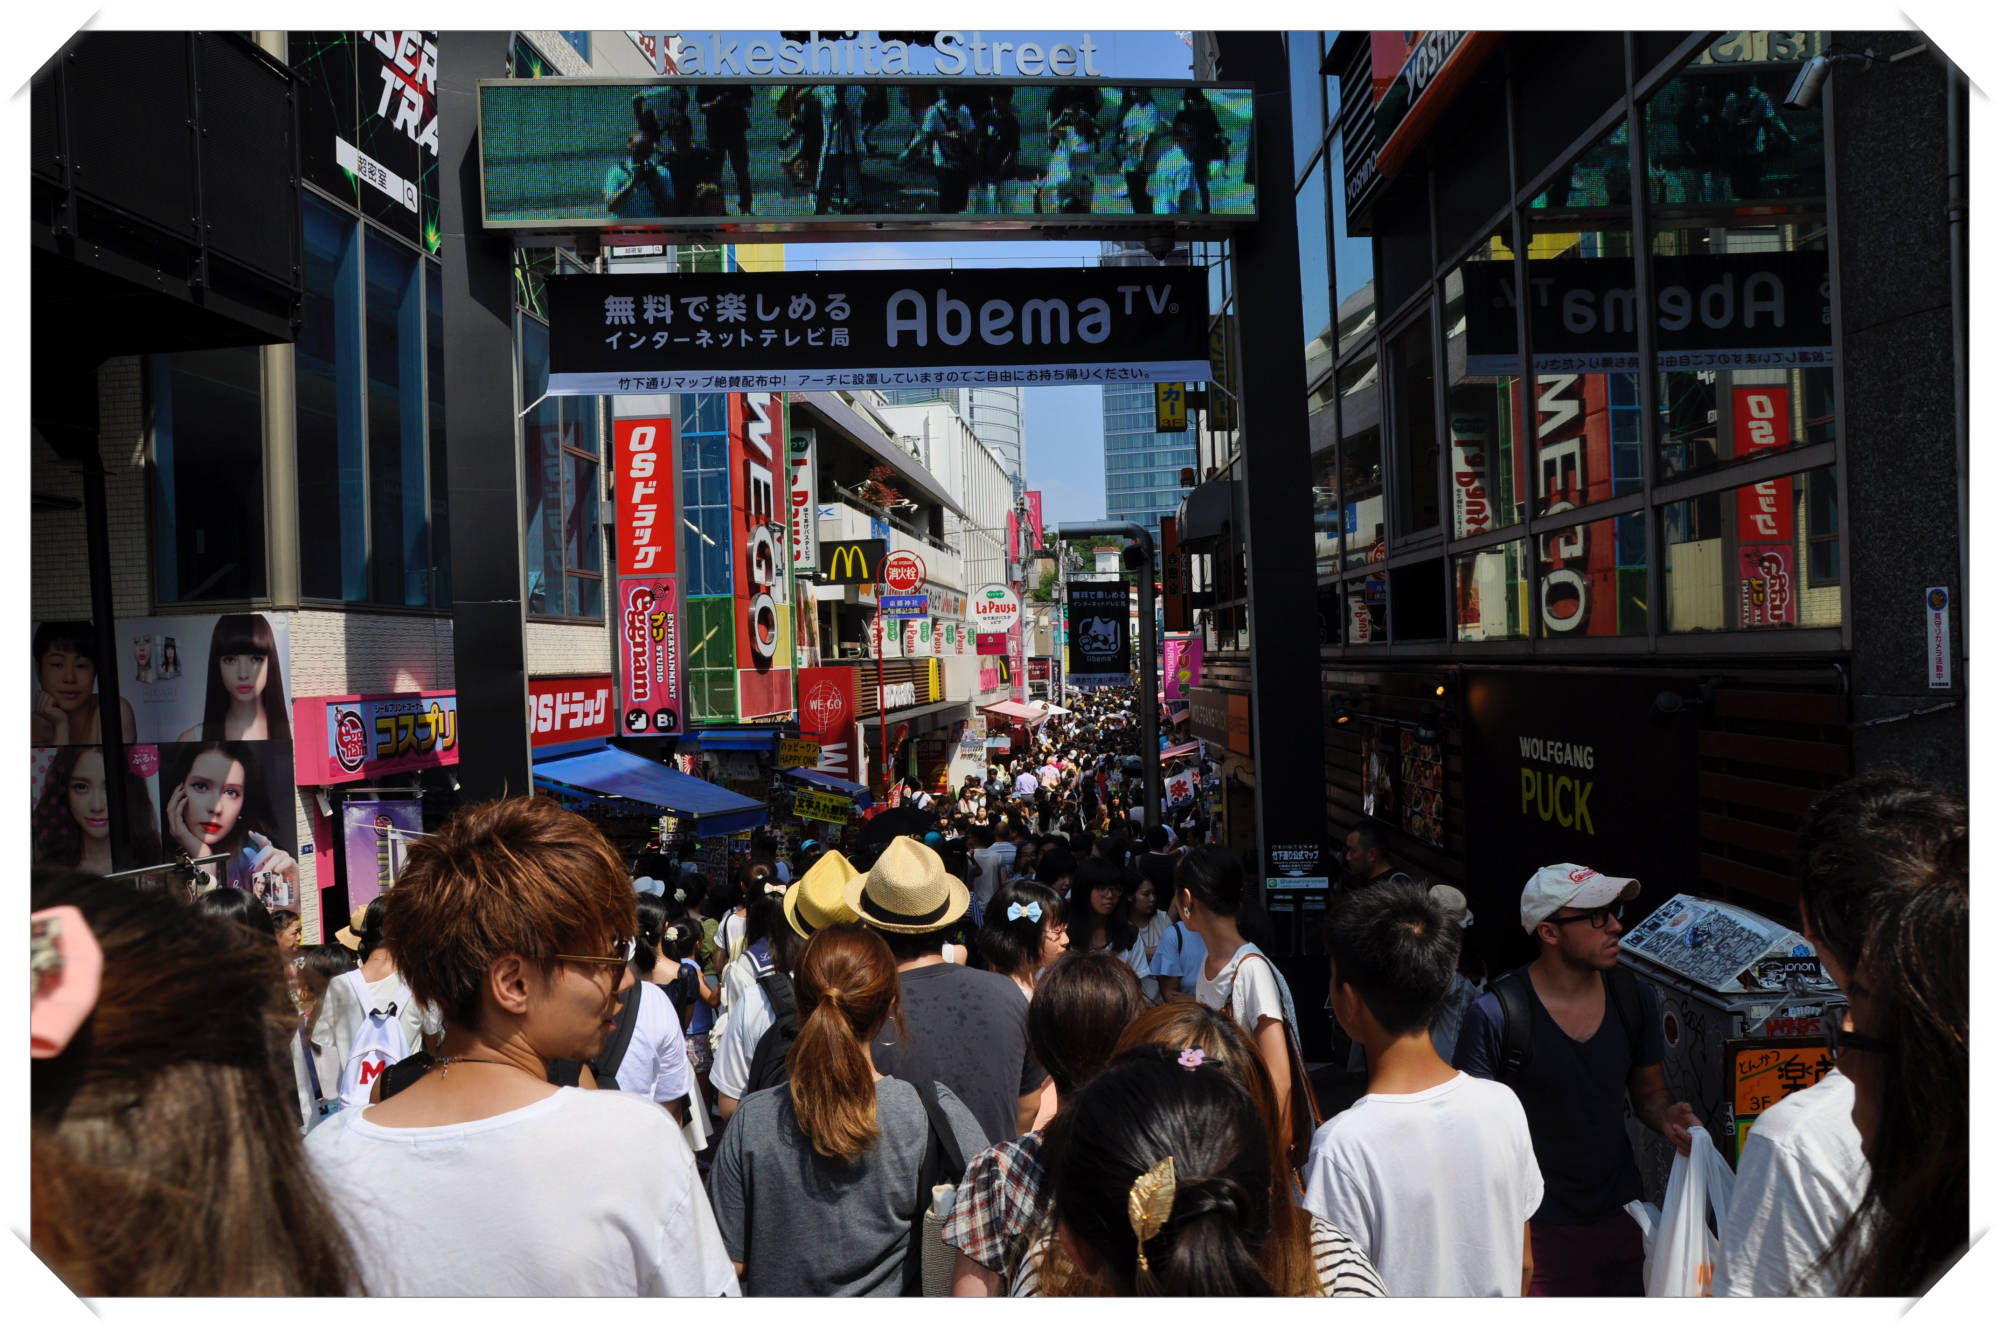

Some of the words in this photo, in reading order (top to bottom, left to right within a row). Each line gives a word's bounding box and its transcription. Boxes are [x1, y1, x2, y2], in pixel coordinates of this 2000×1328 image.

[640, 31, 910, 75] Takeshita
[934, 31, 1100, 76] Street
[604, 293, 852, 325] 無料で楽しめる
[886, 288, 1112, 348] Abema
[604, 327, 852, 350] インターネットテレビ局
[1161, 382, 1181, 416] カー
[629, 426, 661, 569] OSドラッグ
[888, 566, 917, 580] 消火栓
[989, 601, 1016, 614] Pausa
[651, 612, 666, 641] プリ
[656, 646, 664, 683] STUDIO
[667, 613, 676, 699] ENTERTAINMENT
[376, 702, 456, 757] コスプリ
[657, 714, 674, 727] B1
[1520, 736, 1594, 770] WOLFGANG
[1521, 768, 1595, 836] PUCK
[359, 1060, 386, 1084] M
[1739, 1051, 1781, 1074] とんかつ
[1749, 1096, 1771, 1111] 3F
